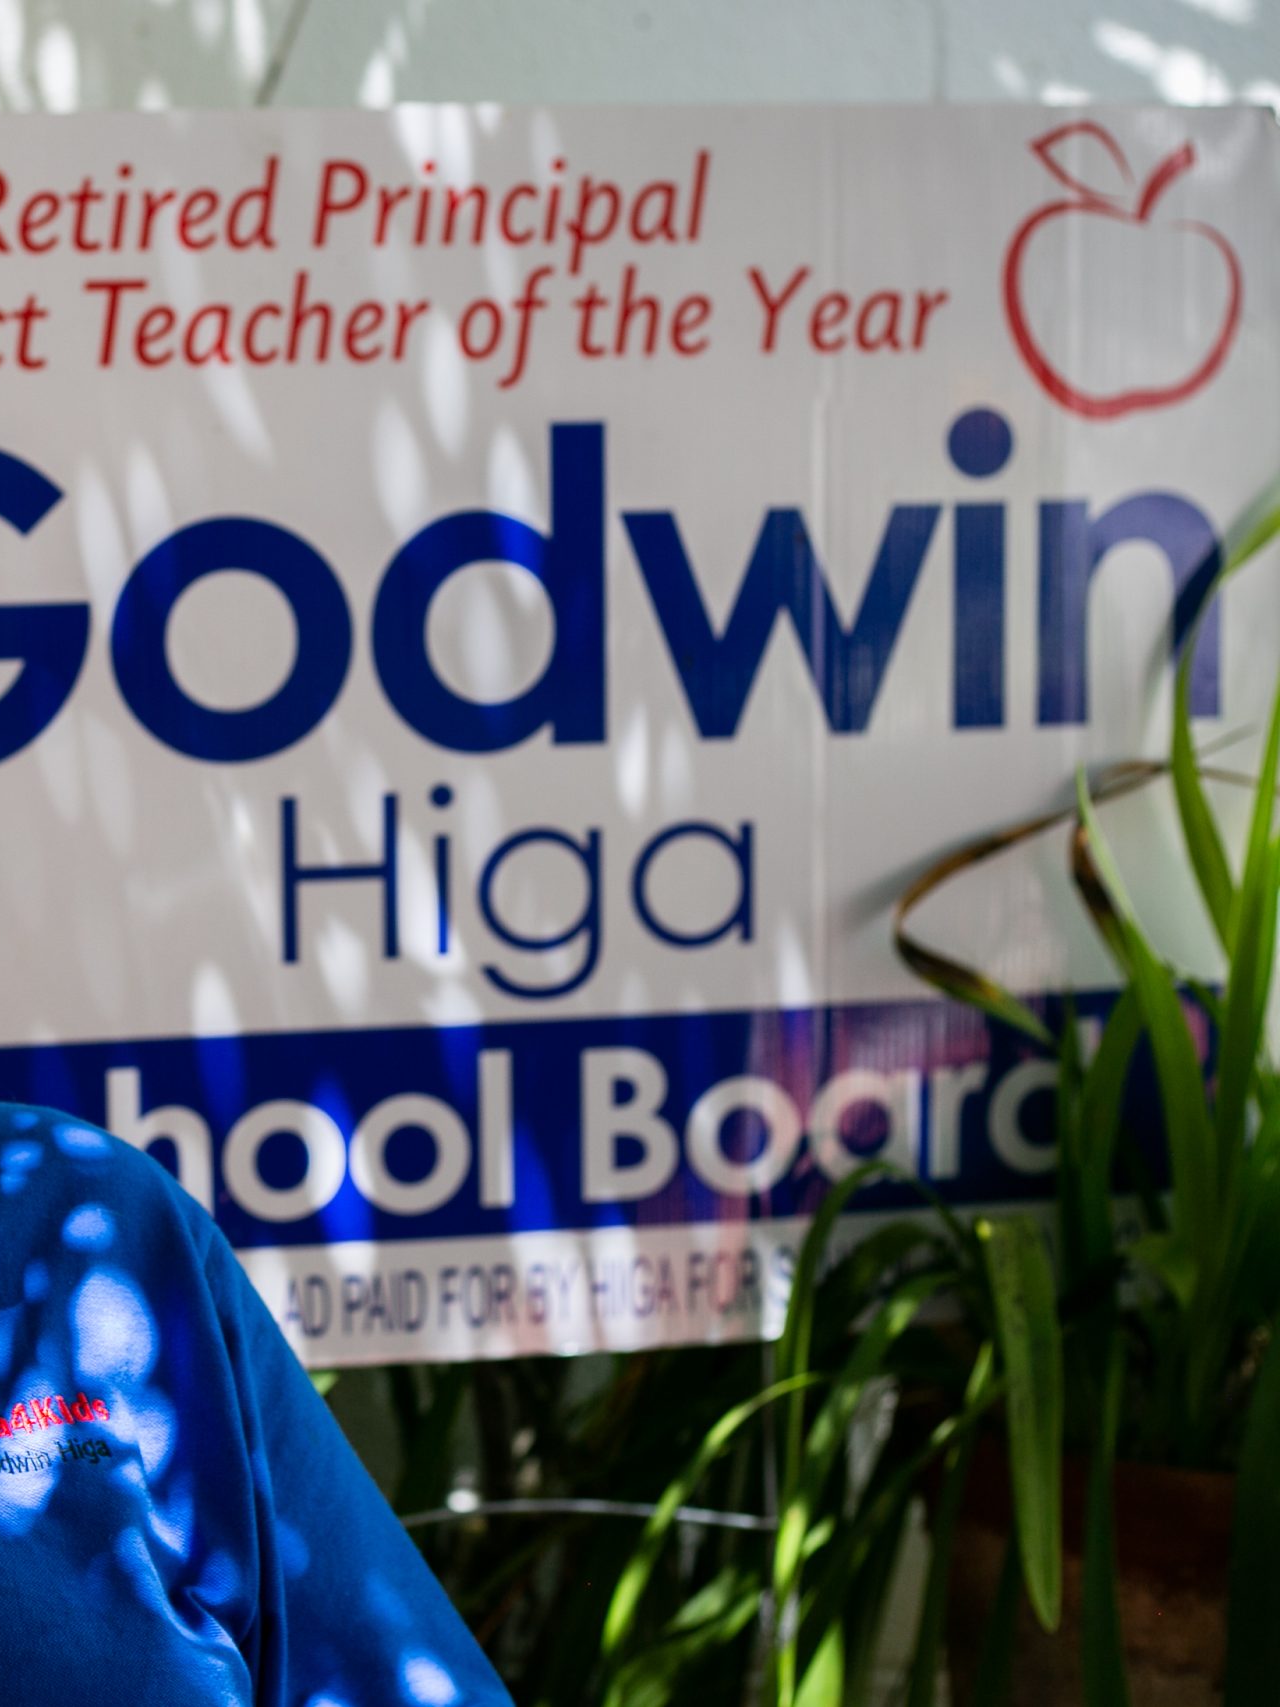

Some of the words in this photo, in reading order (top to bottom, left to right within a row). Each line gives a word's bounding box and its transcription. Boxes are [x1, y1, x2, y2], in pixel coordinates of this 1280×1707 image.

[313, 148, 710, 275] Principal
[83, 270, 428, 370] Teacher
[457, 266, 554, 389] of
[577, 266, 712, 357] the
[748, 266, 949, 354] Year
[281, 784, 756, 999] Higa
[341, 1267, 429, 1334] PAID
[440, 1263, 518, 1328] FOR
[526, 1260, 582, 1325] BY
[590, 1253, 680, 1320] HIGA
[689, 1248, 762, 1314] FOR
[56, 1438, 112, 1465] Higa
